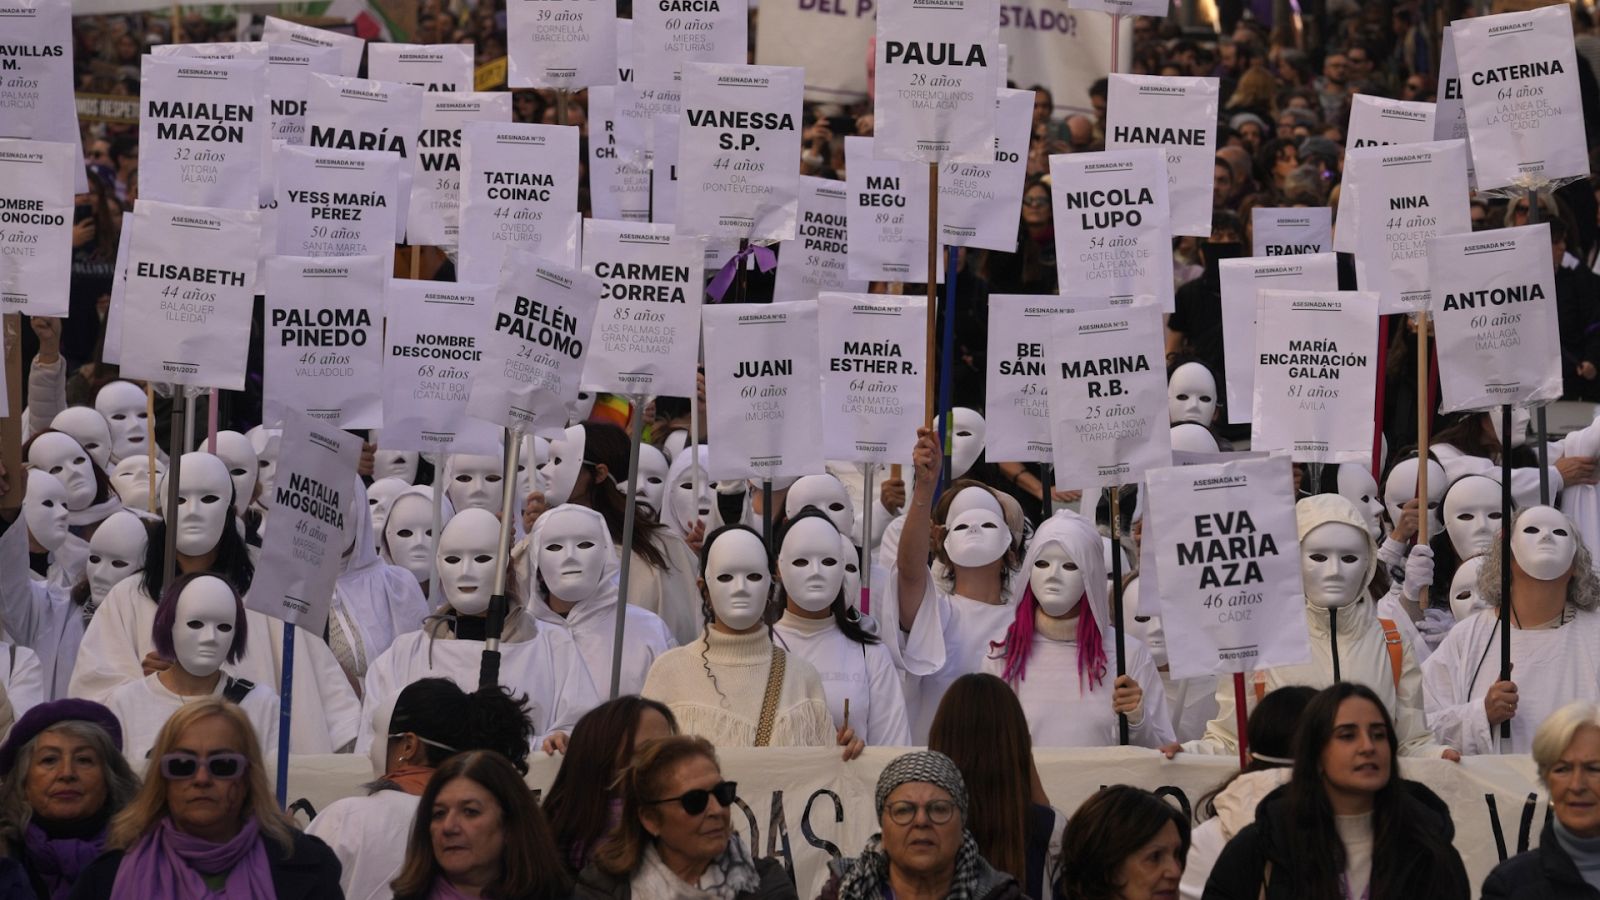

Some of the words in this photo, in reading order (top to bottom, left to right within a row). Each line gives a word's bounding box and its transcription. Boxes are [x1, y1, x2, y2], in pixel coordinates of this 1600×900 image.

[537, 9, 551, 21] 39
[555, 10, 583, 21] años
[665, 18, 681, 30] 60
[684, 19, 714, 31] años
[1488, 24, 1522, 33] ASESINADA
[532, 34, 590, 42] (BARCELONA)
[673, 34, 706, 42] MIERES
[664, 42, 715, 52] (ASTURIAS)
[886, 41, 987, 67] PAULA
[3, 59, 21, 70] M.
[178, 68, 210, 76] ASESINADA
[1472, 60, 1564, 86] CATERINA
[7, 76, 39, 88] años
[910, 73, 928, 86] 28
[930, 74, 962, 88] años
[897, 89, 974, 101] TORREMOLINOS
[1498, 87, 1512, 101] 64
[1516, 85, 1544, 98] años
[148, 101, 253, 122] MAIALEN
[687, 109, 795, 130] VANESSA
[157, 121, 243, 143] MAZÓN
[1114, 126, 1205, 146] HANANE
[310, 125, 407, 158] MARÍA
[719, 133, 760, 151] S.P.
[174, 148, 191, 160] 32
[194, 149, 226, 162] años
[1382, 155, 1415, 163] ASESINADA
[181, 165, 217, 174] VITORIA
[713, 158, 730, 170] 44
[733, 158, 765, 172] años
[961, 165, 992, 179] años
[436, 178, 450, 190] 36
[484, 172, 555, 187] TATIANA
[953, 179, 978, 189] REUS
[487, 187, 551, 201] COINAC
[702, 183, 774, 194] (PONTEVEDRA)
[288, 190, 329, 204] YESS
[333, 191, 387, 207] MARÍA
[1066, 187, 1154, 209] NICOLA
[1390, 195, 1429, 210] NINA
[311, 205, 362, 221] PÉREZ
[494, 207, 508, 219] 44
[513, 207, 543, 221] años
[1082, 209, 1142, 230] LUPO
[171, 216, 207, 225] ASESINADA
[1387, 216, 1402, 229] 44
[1406, 215, 1436, 228] años
[310, 225, 327, 239] 50
[330, 227, 360, 240] años
[500, 223, 535, 233] OVIEDO
[8, 231, 38, 244] años
[491, 232, 542, 242] (ASTURIAS)
[1089, 236, 1104, 249] 54
[1108, 235, 1138, 248] años
[1386, 231, 1437, 242] ROQUETAS
[303, 241, 333, 250] SANTA
[336, 242, 367, 252] MARTA
[1393, 242, 1412, 251] DEL
[1464, 243, 1498, 252] ASESINADA
[821, 257, 845, 270] años
[1107, 259, 1137, 269] PLANA
[137, 262, 245, 287] ELISABETH
[595, 262, 690, 283] CARMEN
[161, 285, 179, 298] 44
[183, 287, 216, 302] años
[600, 282, 686, 304] CORREA
[1443, 284, 1545, 311] ANTONIA
[160, 302, 215, 314] BALAGUER
[613, 307, 630, 320] 85
[633, 309, 665, 322] años
[166, 312, 207, 323] (LLEIDA)
[272, 309, 371, 327] PALOMA
[514, 296, 577, 336] BELÉN
[1470, 315, 1487, 329] 60
[1491, 312, 1522, 325] años
[601, 324, 619, 333] LAS
[622, 323, 661, 335] PALMAS
[1078, 322, 1112, 331] ASESINADA
[281, 329, 367, 347] PINEDO
[416, 334, 475, 348] NOMBRE
[495, 312, 583, 360] PALOMO
[602, 332, 628, 341] GRAN
[631, 334, 674, 345] CANARIA
[628, 343, 671, 354] PALMAS)
[844, 340, 902, 357] MARÍA
[1289, 338, 1338, 353] MARÍA
[300, 352, 316, 365] 46
[320, 352, 350, 365] años
[517, 345, 531, 359] 24
[534, 352, 561, 370] años
[1260, 353, 1367, 367] ENCARNACIÓN
[295, 368, 354, 377] VALLADOLID
[418, 364, 434, 378] 68
[438, 366, 470, 380] años
[733, 360, 793, 379] JUANI
[830, 358, 898, 375] ESTHER
[902, 361, 918, 375] R.
[1061, 355, 1150, 379] MARINA
[1289, 365, 1340, 379] GALÁN
[420, 381, 445, 391] SANT
[741, 385, 756, 398] 60
[760, 384, 787, 397] años
[850, 379, 864, 393] 64
[868, 381, 897, 394] años
[1020, 383, 1036, 396] 45
[1088, 380, 1129, 399] R.B.
[1288, 385, 1302, 398] 81
[1306, 385, 1340, 398] años
[751, 401, 779, 410] YECLA
[847, 395, 866, 405] SAN
[869, 396, 899, 406] MATEO
[745, 411, 785, 421] (MURCIA)
[866, 406, 903, 416] PALMAS)
[1085, 405, 1101, 420] 25
[1105, 403, 1136, 417] años
[1122, 418, 1146, 428] NOVA
[1080, 429, 1143, 442] (TARRAGONA)
[1193, 477, 1232, 487] ASESINADA
[289, 472, 339, 510] NATALIA
[276, 487, 344, 531] MOSQUERA
[1195, 511, 1256, 538] EVA
[309, 525, 328, 544] años
[1176, 533, 1279, 566] MARÍA
[1199, 561, 1264, 590] AZA
[1203, 595, 1223, 609] 46
[1228, 590, 1263, 607] años
[1218, 609, 1252, 623] CÁDIZ
